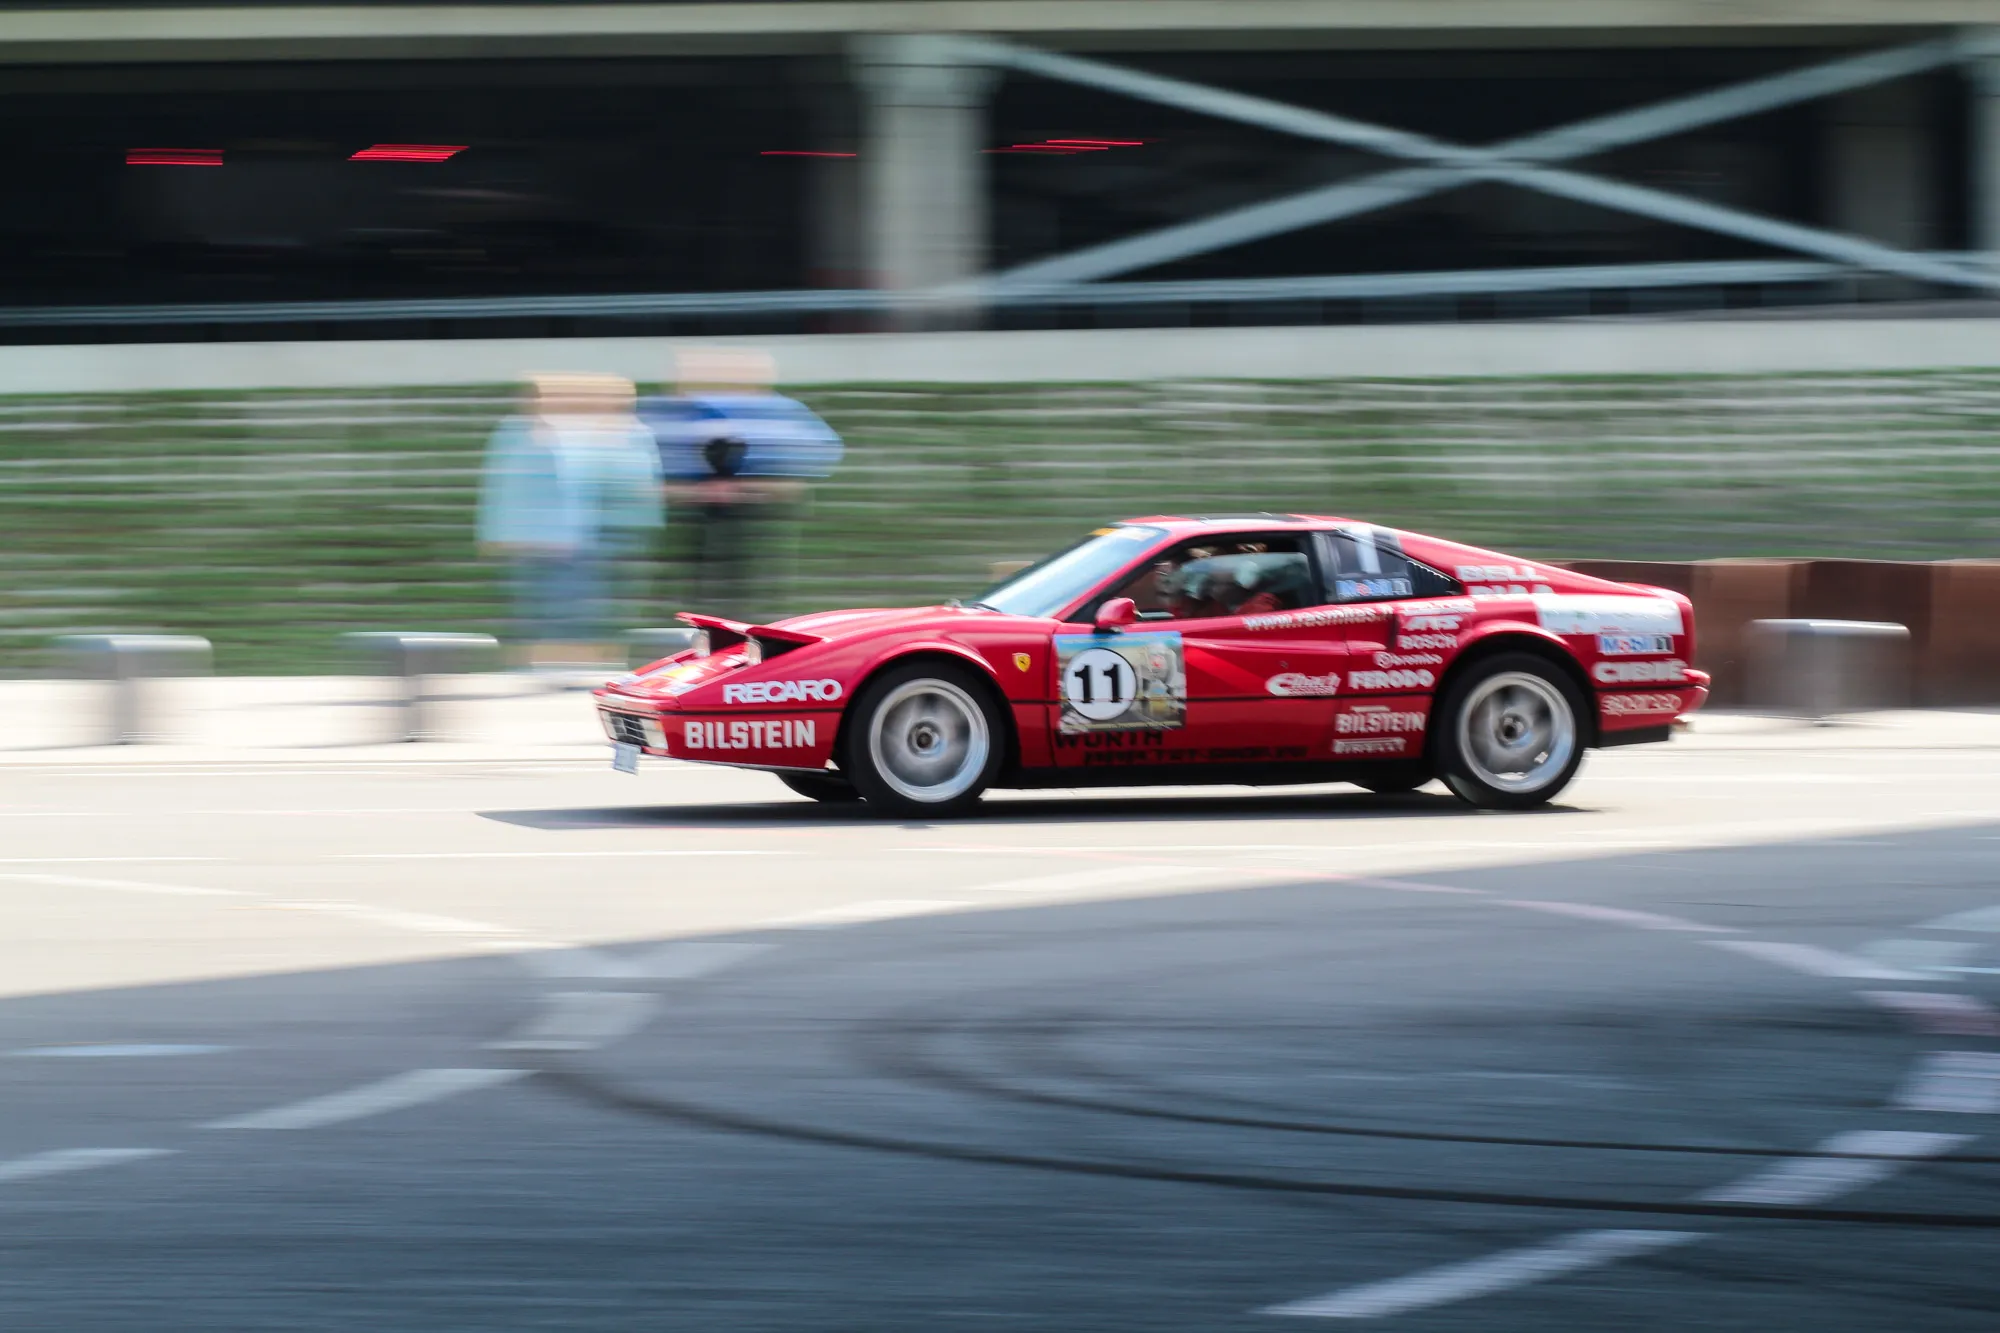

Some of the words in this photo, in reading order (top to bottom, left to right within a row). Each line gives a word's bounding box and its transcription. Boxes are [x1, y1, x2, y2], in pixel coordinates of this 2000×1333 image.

[1455, 565, 1547, 581] BELL
[1398, 634, 1458, 649] BOSCH
[1074, 663, 1123, 704] 11
[1348, 669, 1435, 689] FERODO
[723, 679, 843, 704] RECARO
[1335, 712, 1425, 733] BILSTEIN
[684, 719, 816, 749] BILSTEIN
